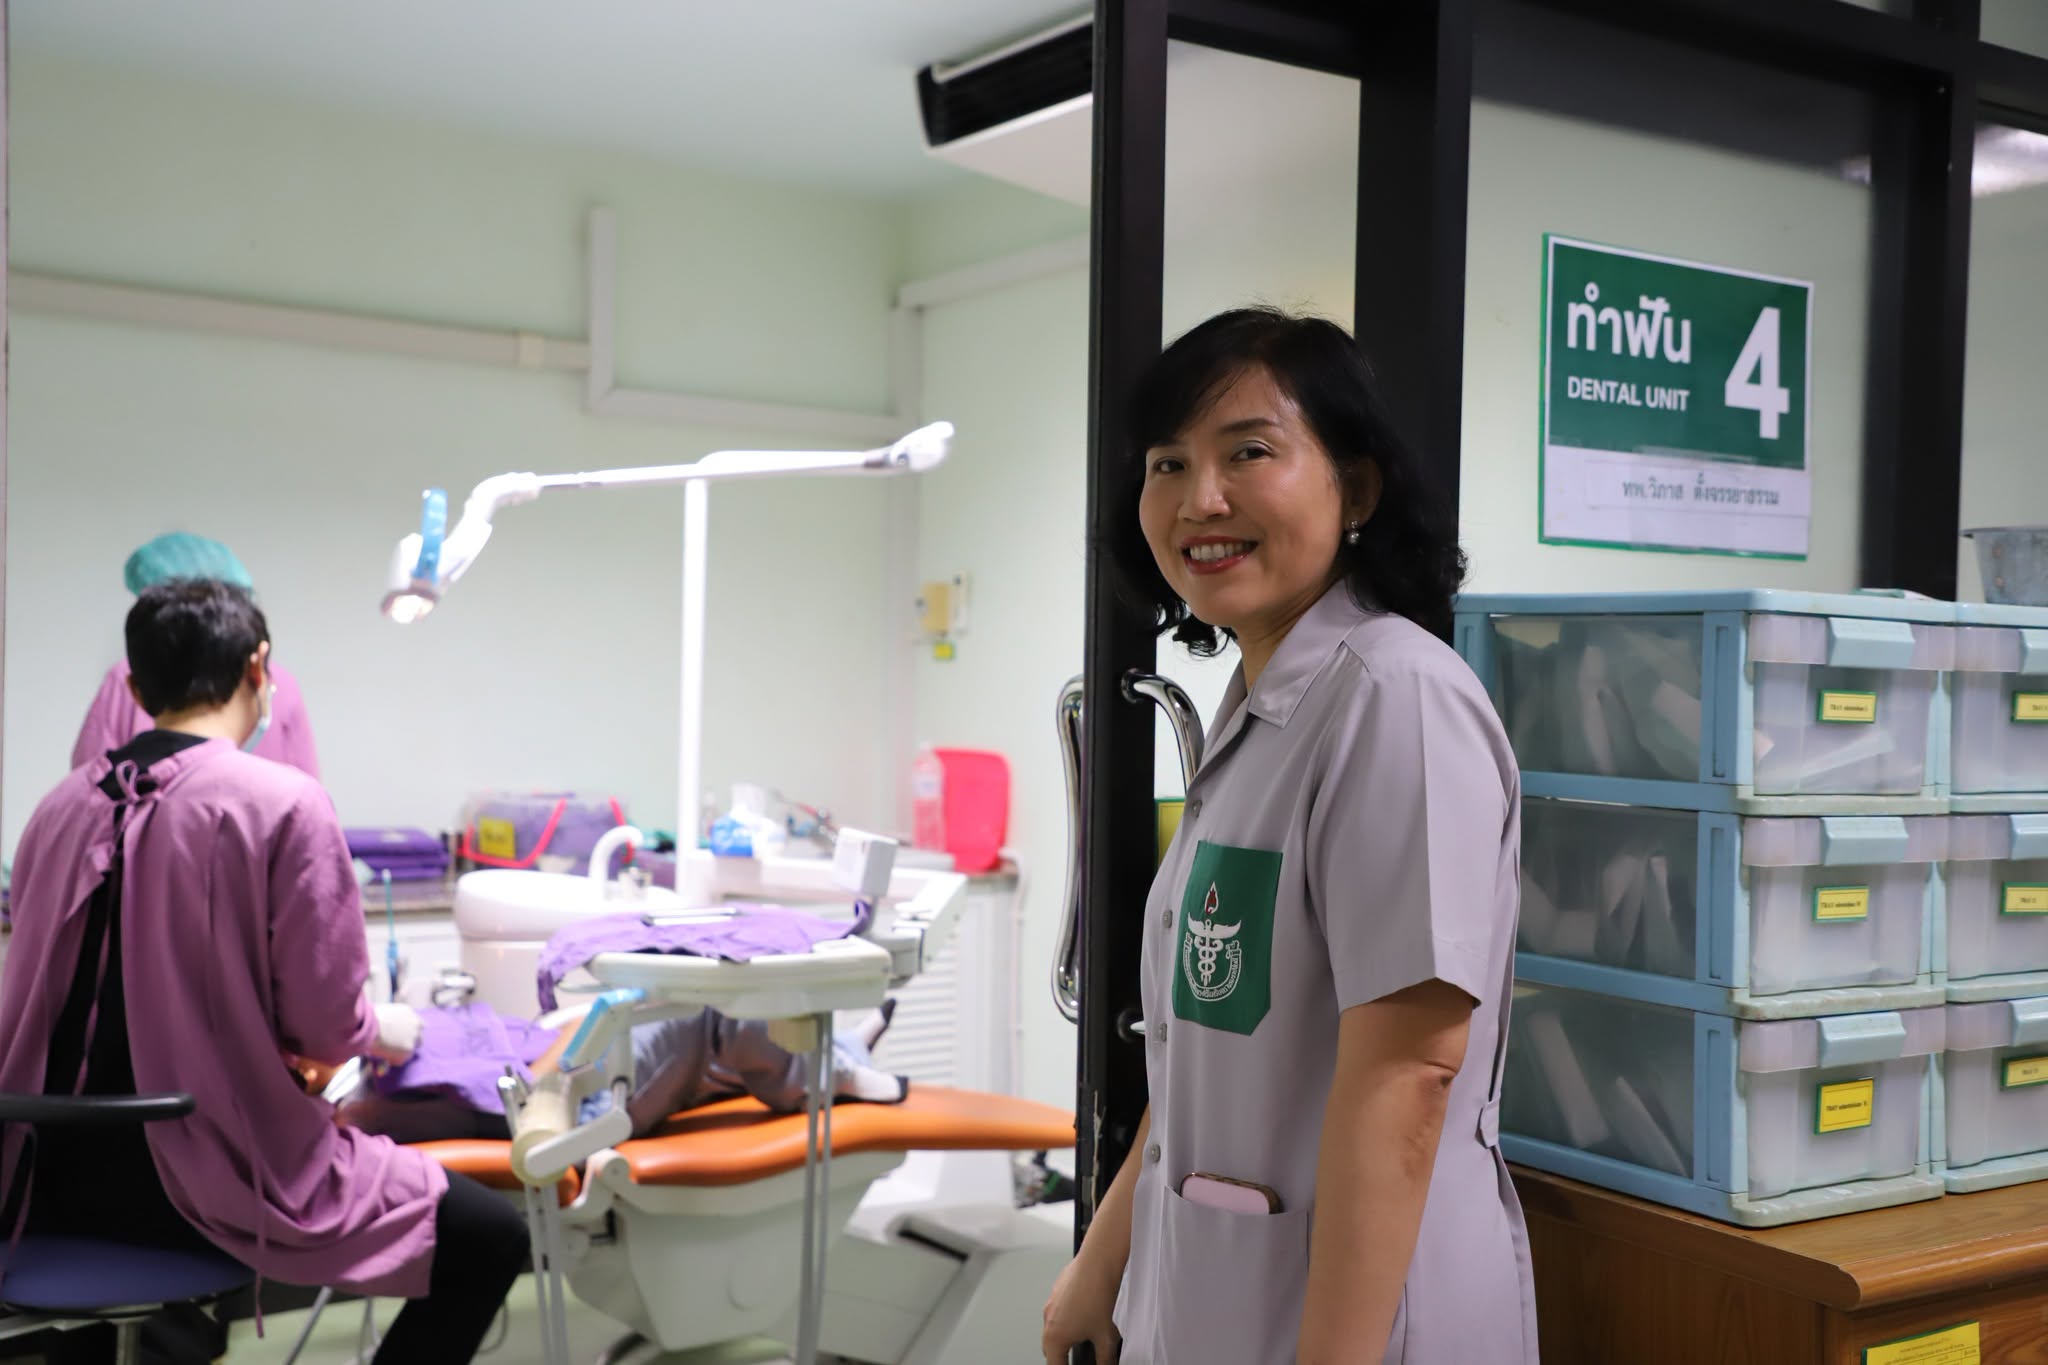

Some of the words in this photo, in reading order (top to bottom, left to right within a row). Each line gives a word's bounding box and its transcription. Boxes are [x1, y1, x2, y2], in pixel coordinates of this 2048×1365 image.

[1567, 281, 1692, 364] ทำฟัน
[1567, 375, 1642, 407] DENTAL
[1645, 384, 1690, 412] UNIT
[1724, 306, 1790, 440] 4
